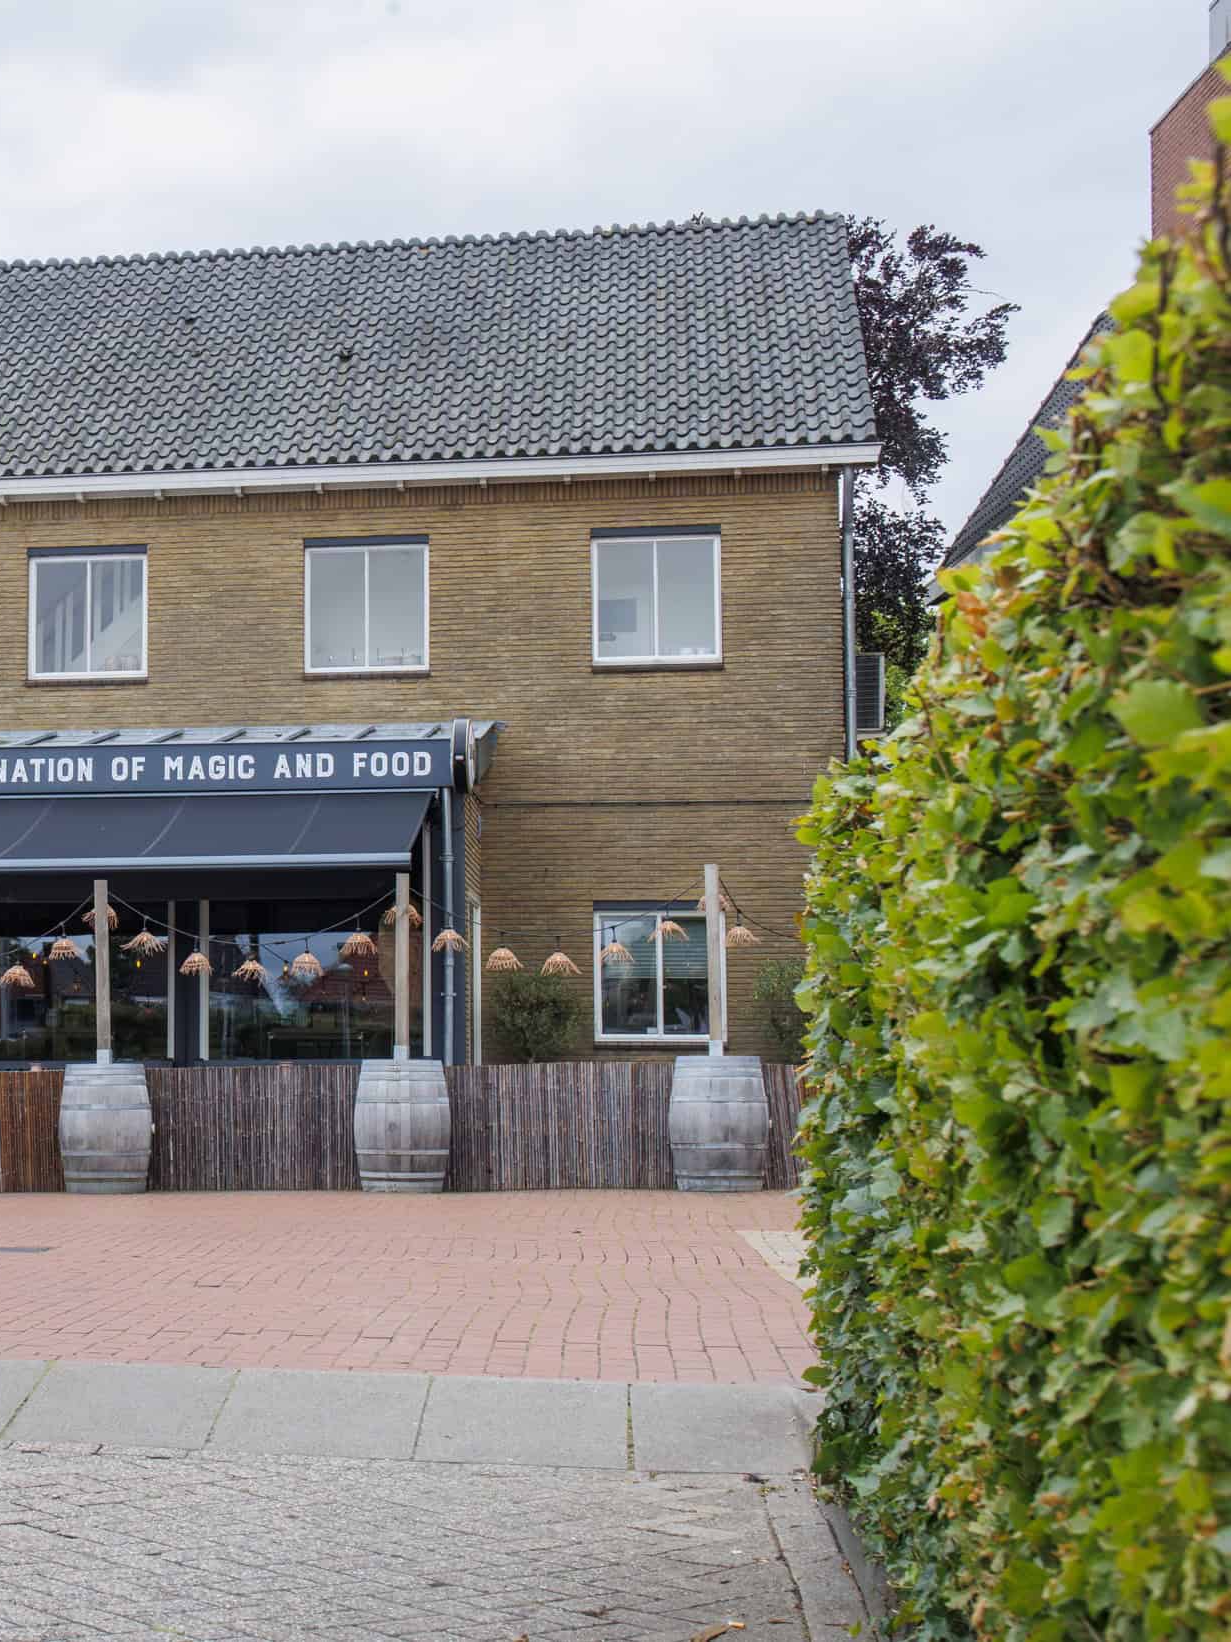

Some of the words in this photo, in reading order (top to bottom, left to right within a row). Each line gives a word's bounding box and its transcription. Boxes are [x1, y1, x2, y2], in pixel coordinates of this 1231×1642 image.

[111, 756, 146, 782] OF
[163, 754, 255, 781] MAGIC
[273, 752, 335, 779] AND
[352, 751, 432, 777] FOOD
